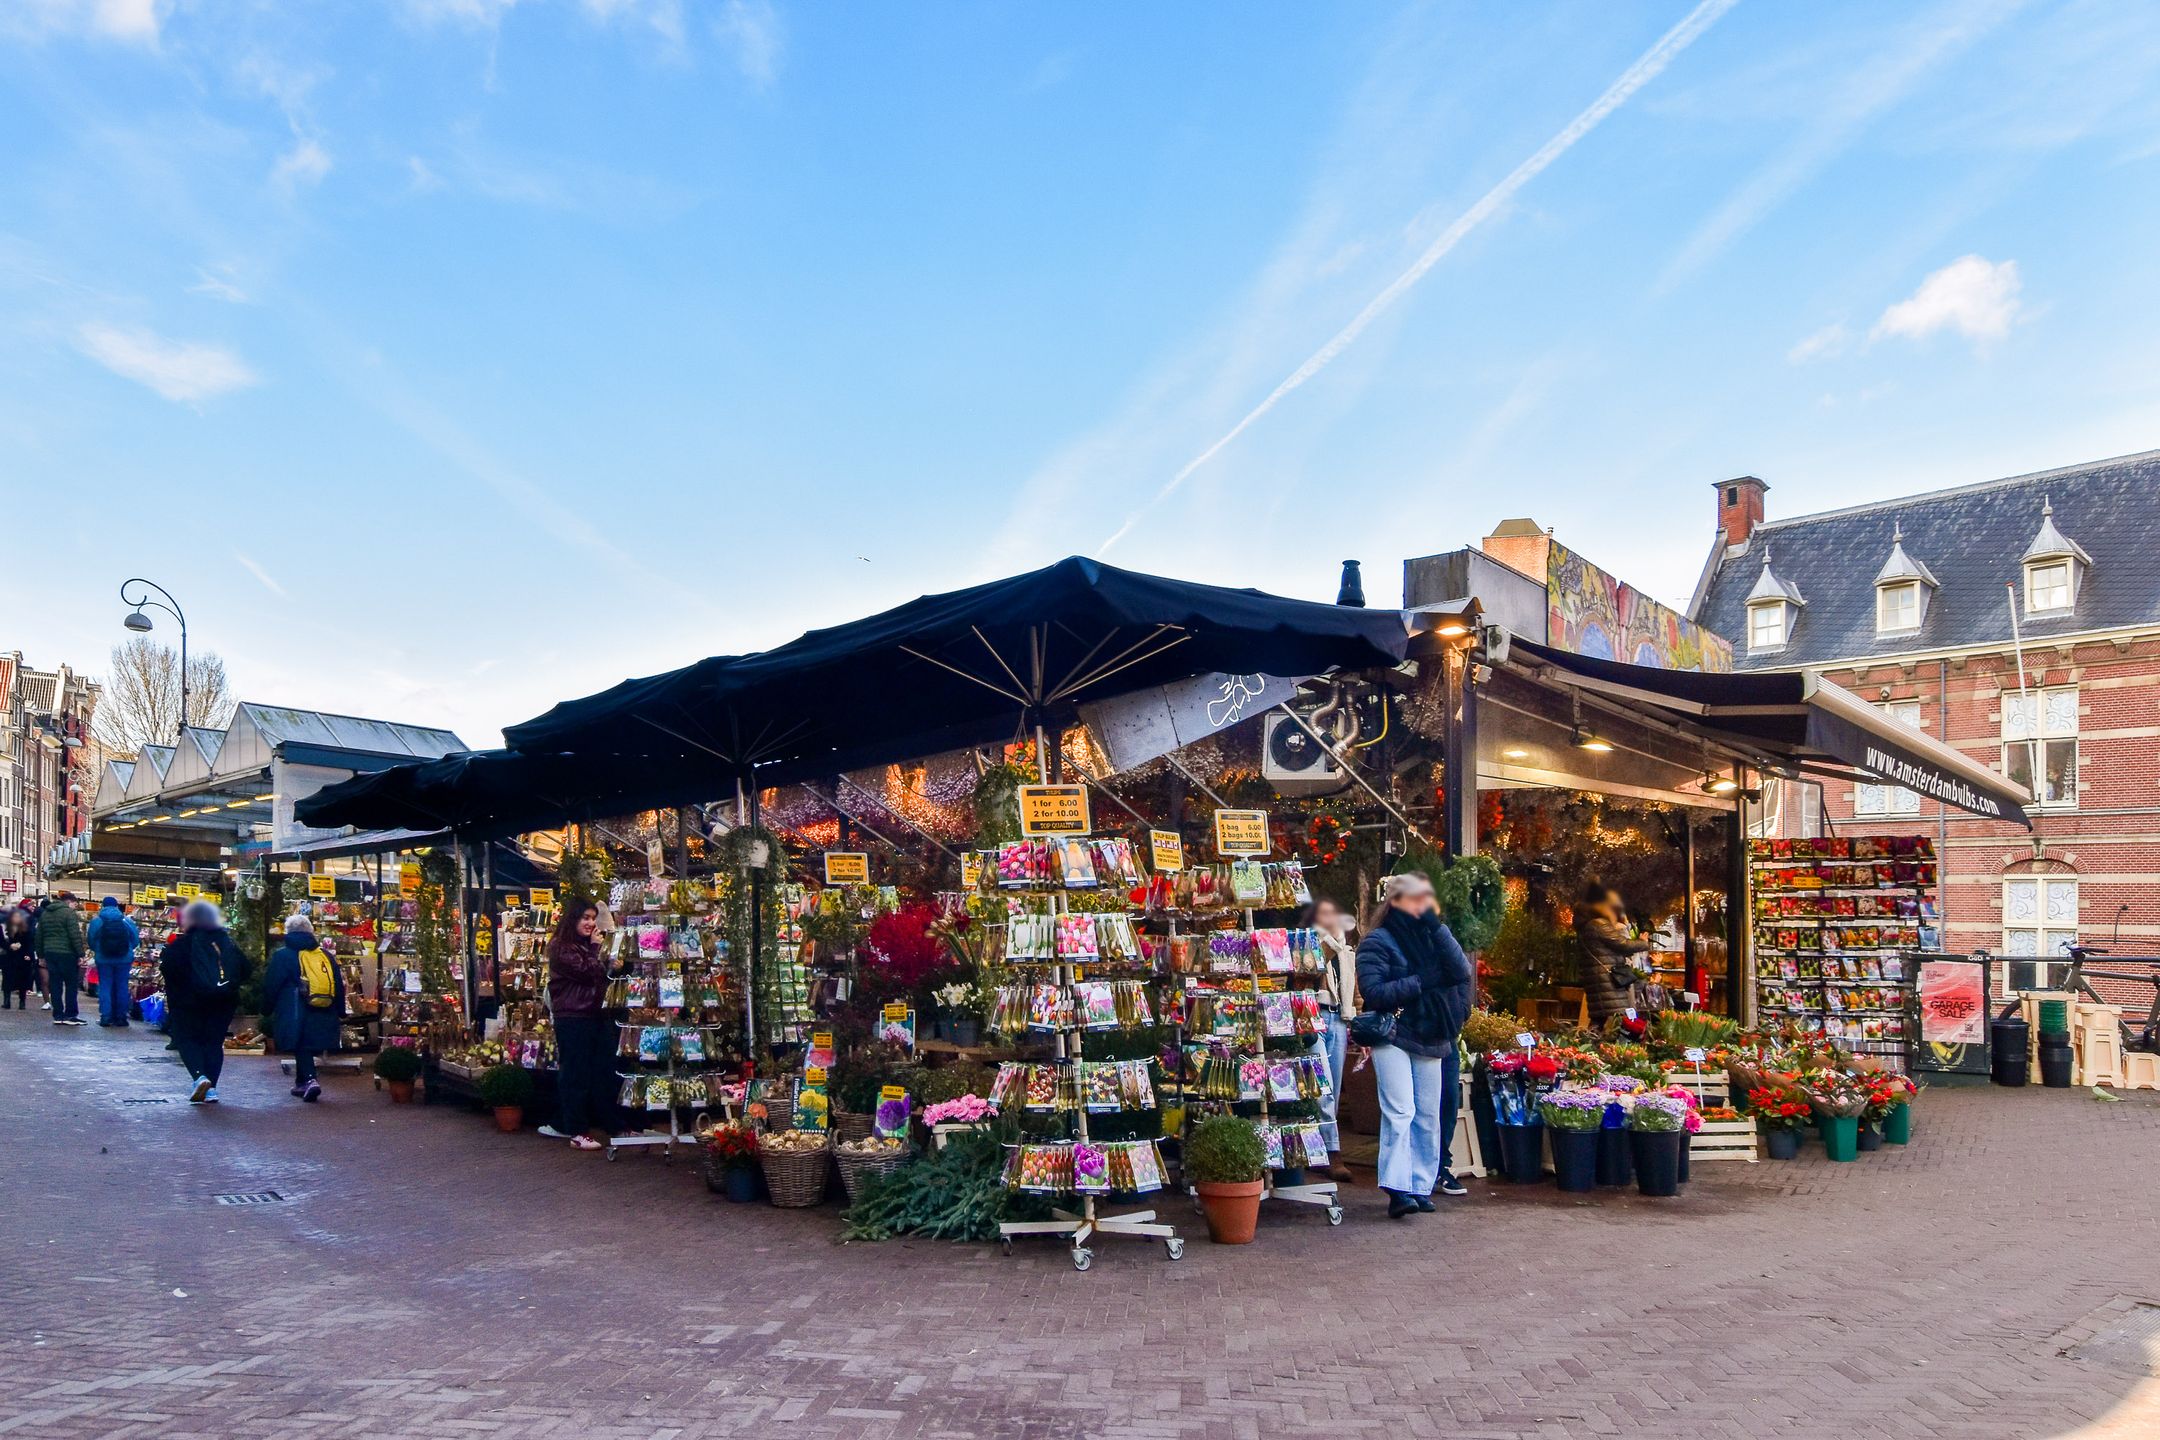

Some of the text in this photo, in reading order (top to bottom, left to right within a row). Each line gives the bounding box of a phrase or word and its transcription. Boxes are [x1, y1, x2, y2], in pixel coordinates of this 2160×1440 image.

[1866, 747, 2000, 815] www.amsterdambulbs.com
[1930, 1001, 1975, 1011] GARAGE
[1939, 1009, 1966, 1019] SALE
